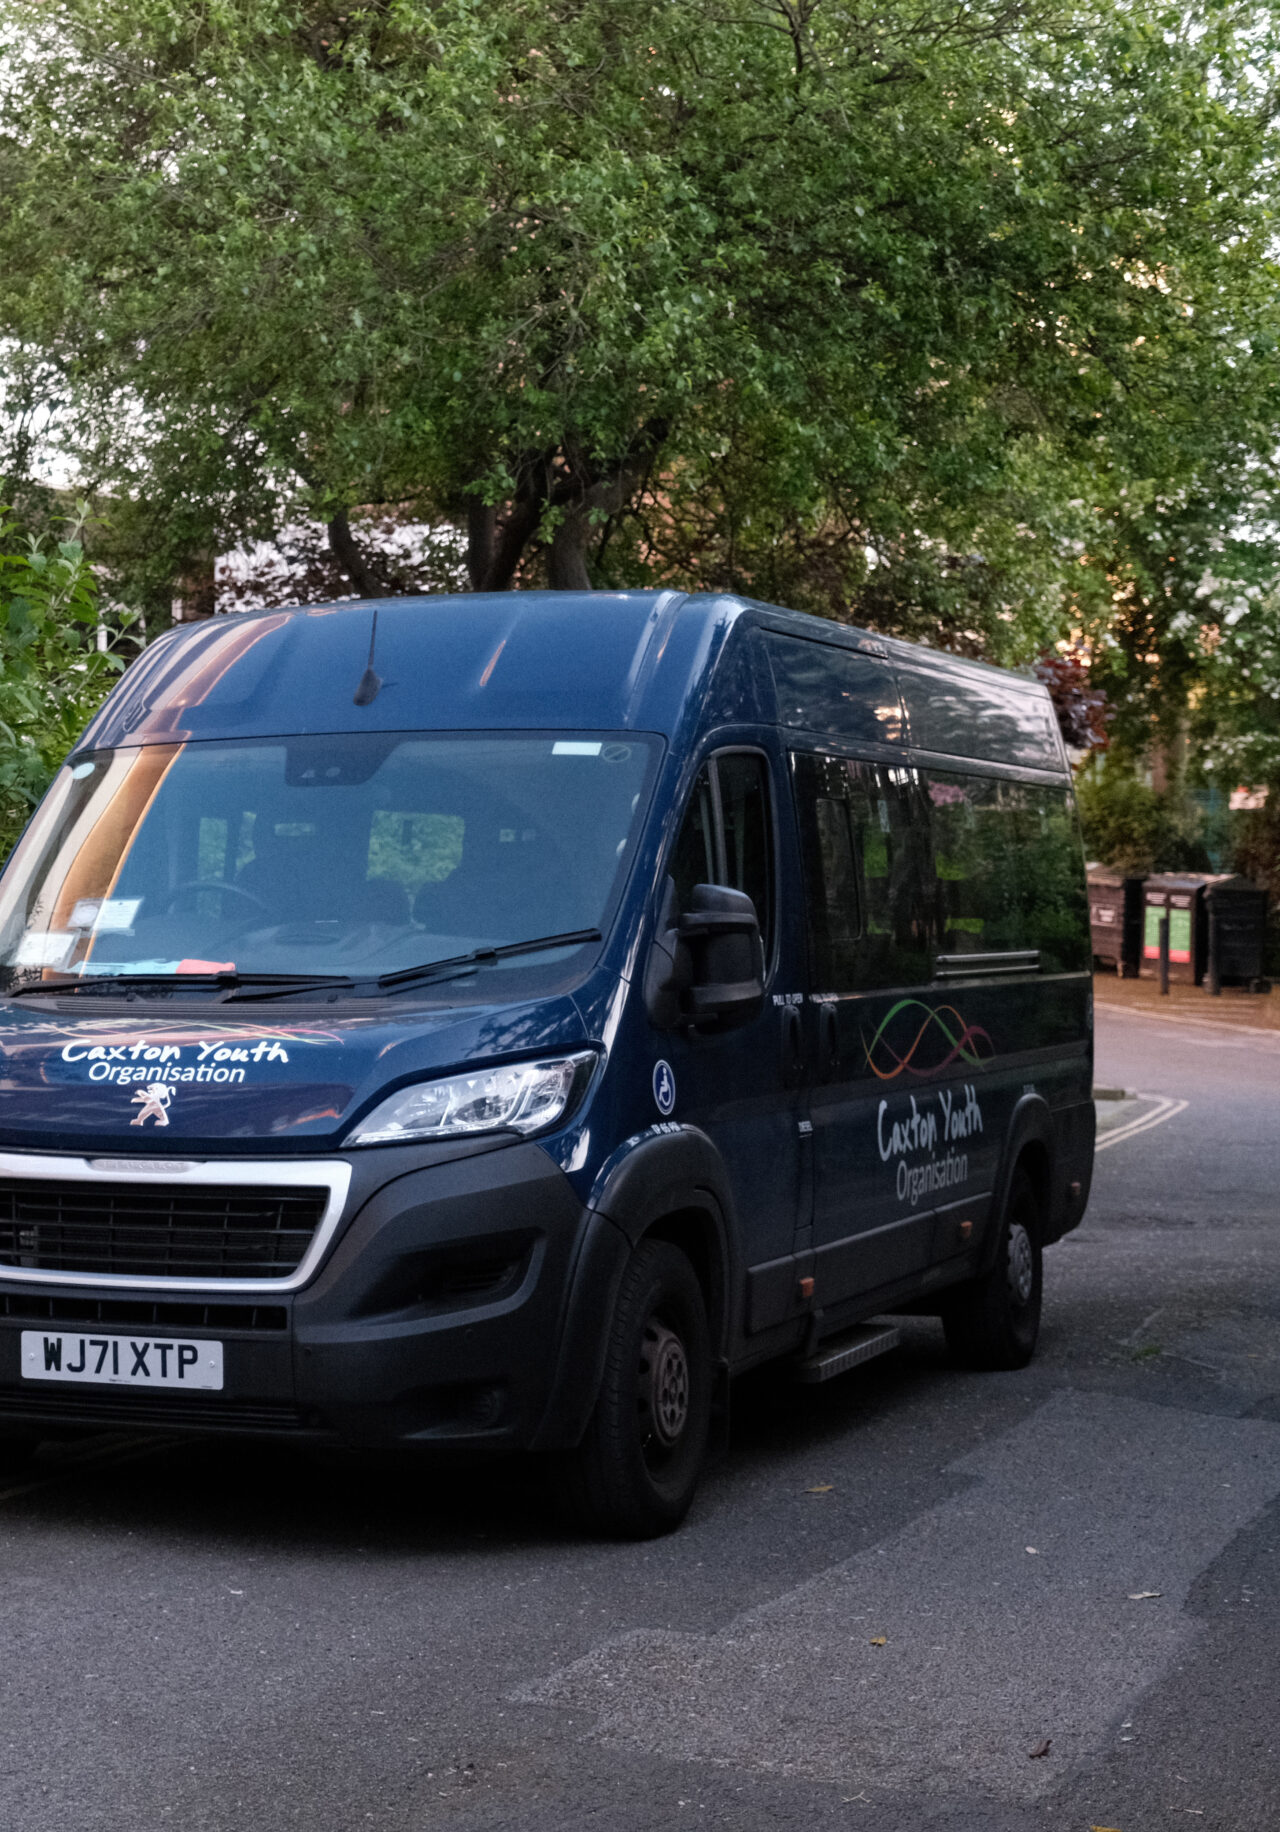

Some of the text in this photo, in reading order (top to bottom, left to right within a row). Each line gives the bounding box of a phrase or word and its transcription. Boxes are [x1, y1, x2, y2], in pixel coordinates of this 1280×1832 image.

[61, 1040, 289, 1063] Caxton Youth
[88, 1061, 246, 1085] Organisation
[877, 1083, 983, 1161] Caxton Youth
[896, 1146, 968, 1206] Organisation
[43, 1336, 199, 1379] WJ71 XTP
